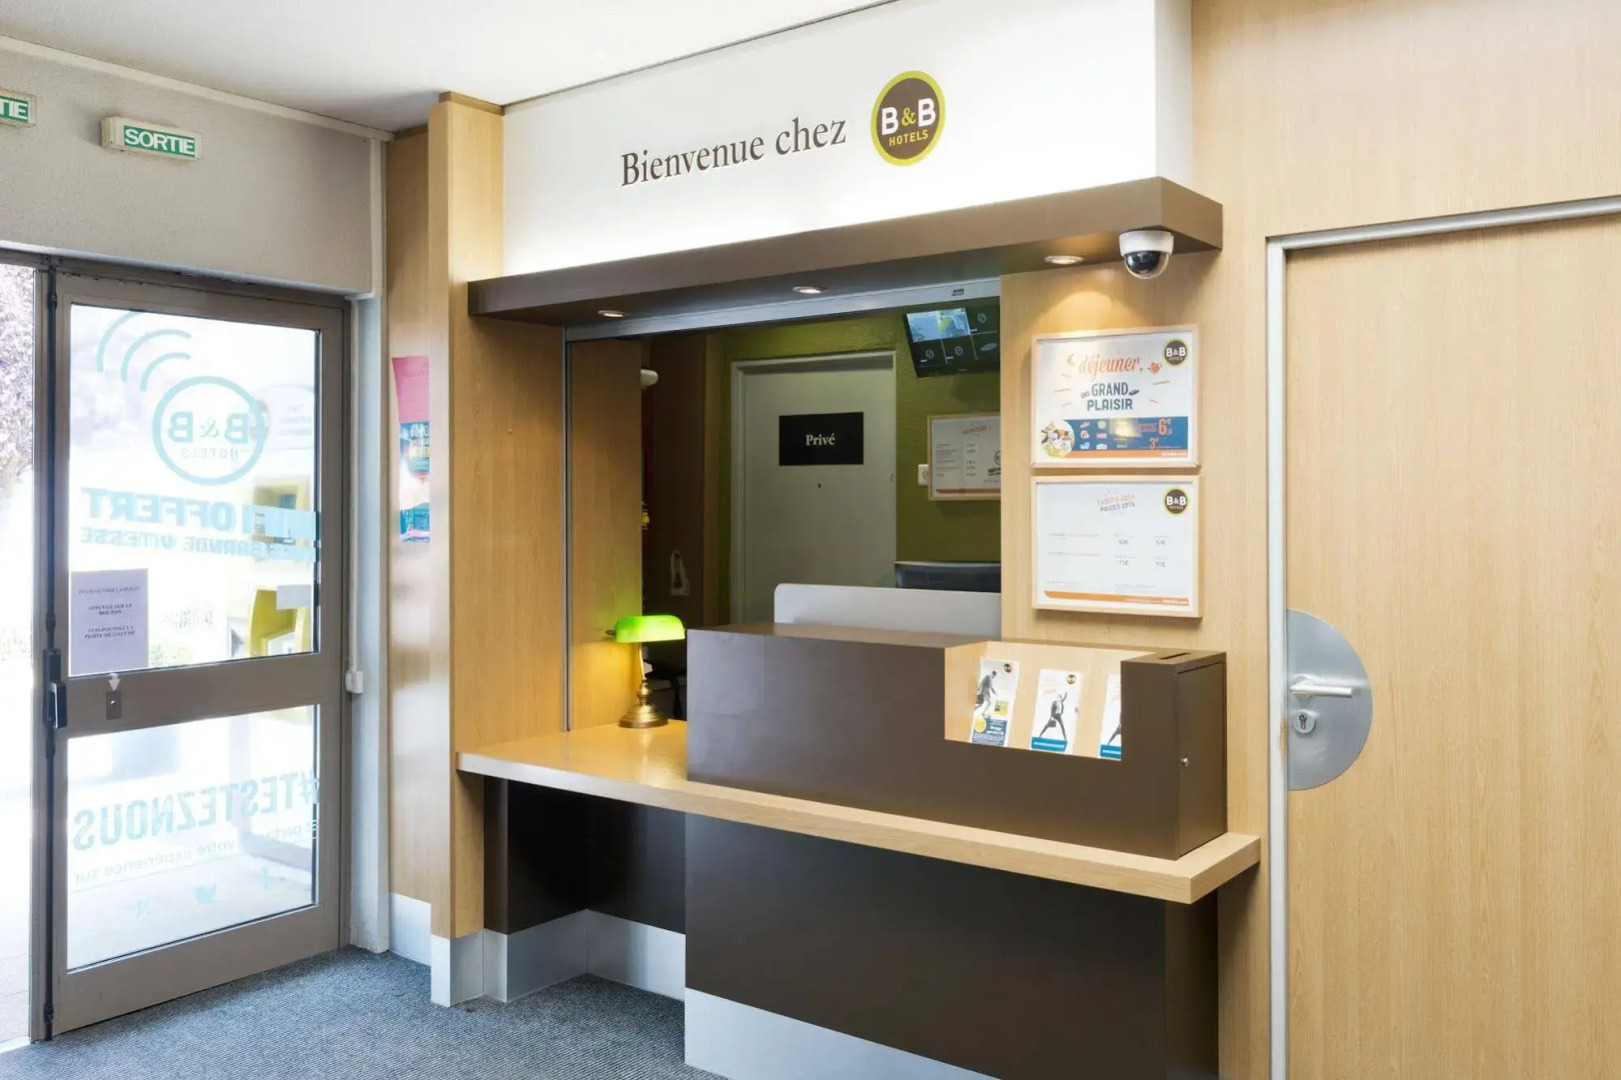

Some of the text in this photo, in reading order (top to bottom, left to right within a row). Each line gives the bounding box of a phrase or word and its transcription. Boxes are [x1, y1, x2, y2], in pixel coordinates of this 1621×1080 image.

[881, 98, 936, 135] B&B
[124, 129, 195, 155] SORTIE
[889, 129, 929, 146] HOTELS
[621, 117, 847, 187] Bienvenue chez
[1166, 347, 1186, 357] B&B
[1091, 382, 1129, 396] GRAND
[1087, 398, 1133, 411] PLAISIR
[806, 433, 835, 446] Privé
[1166, 496, 1186, 505] B&B
